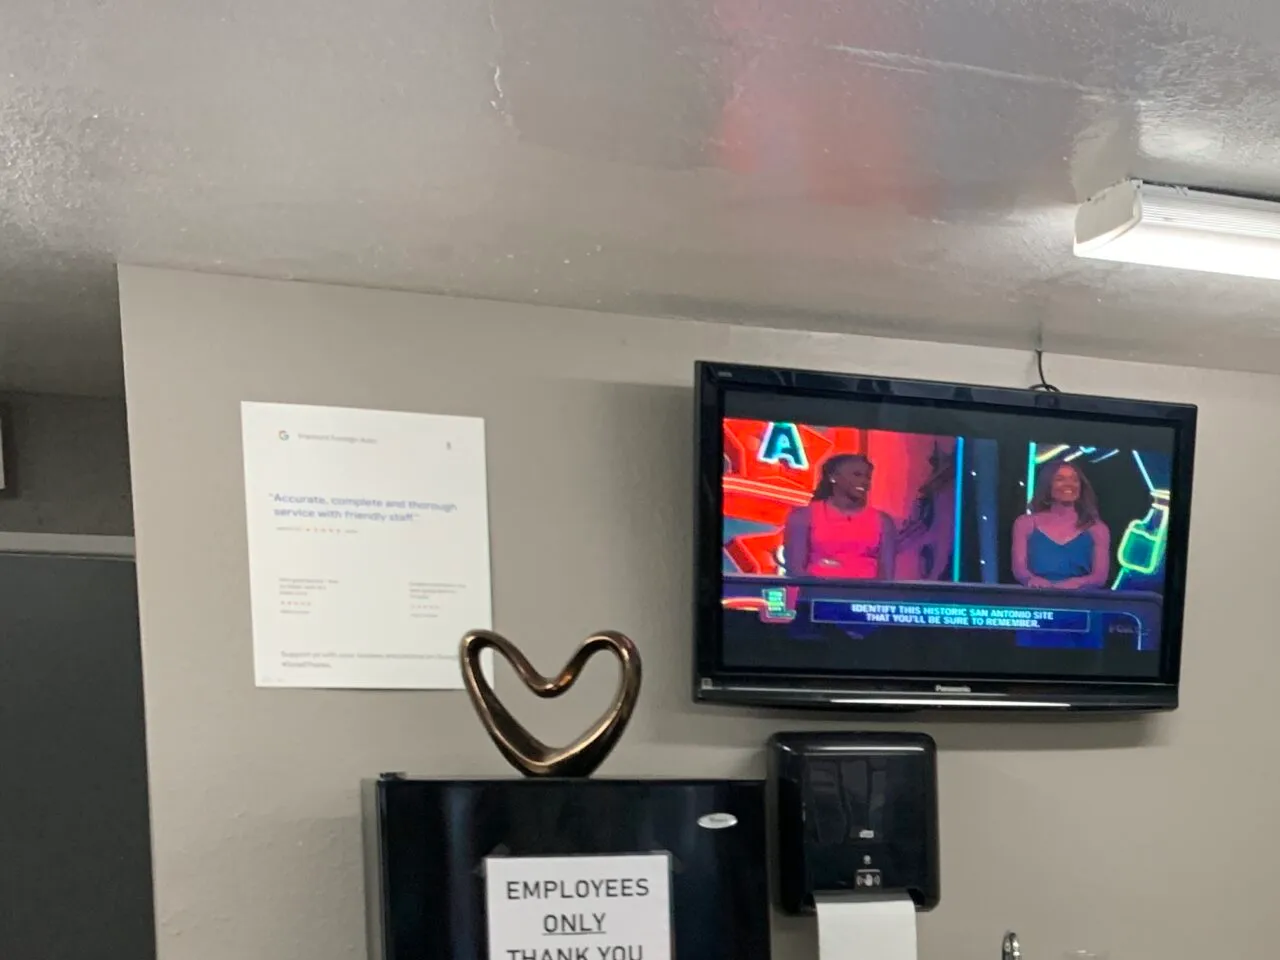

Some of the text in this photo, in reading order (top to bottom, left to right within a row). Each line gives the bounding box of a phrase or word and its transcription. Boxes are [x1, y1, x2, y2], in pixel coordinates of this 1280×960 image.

[331, 497, 383, 511] complete
[385, 500, 406, 509] and
[408, 501, 458, 513] thorough
[273, 508, 316, 518] service
[317, 509, 342, 519] with
[344, 510, 387, 522] friendly
[851, 603, 1054, 620] IDENTIFY THIS HISTORIC SAN ANTONIO SITE
[866, 612, 1041, 629] THAT YOU'LL BE SURE TO REMEMBER.
[506, 878, 650, 900] EMPLOYEES
[543, 912, 607, 935] ONLY
